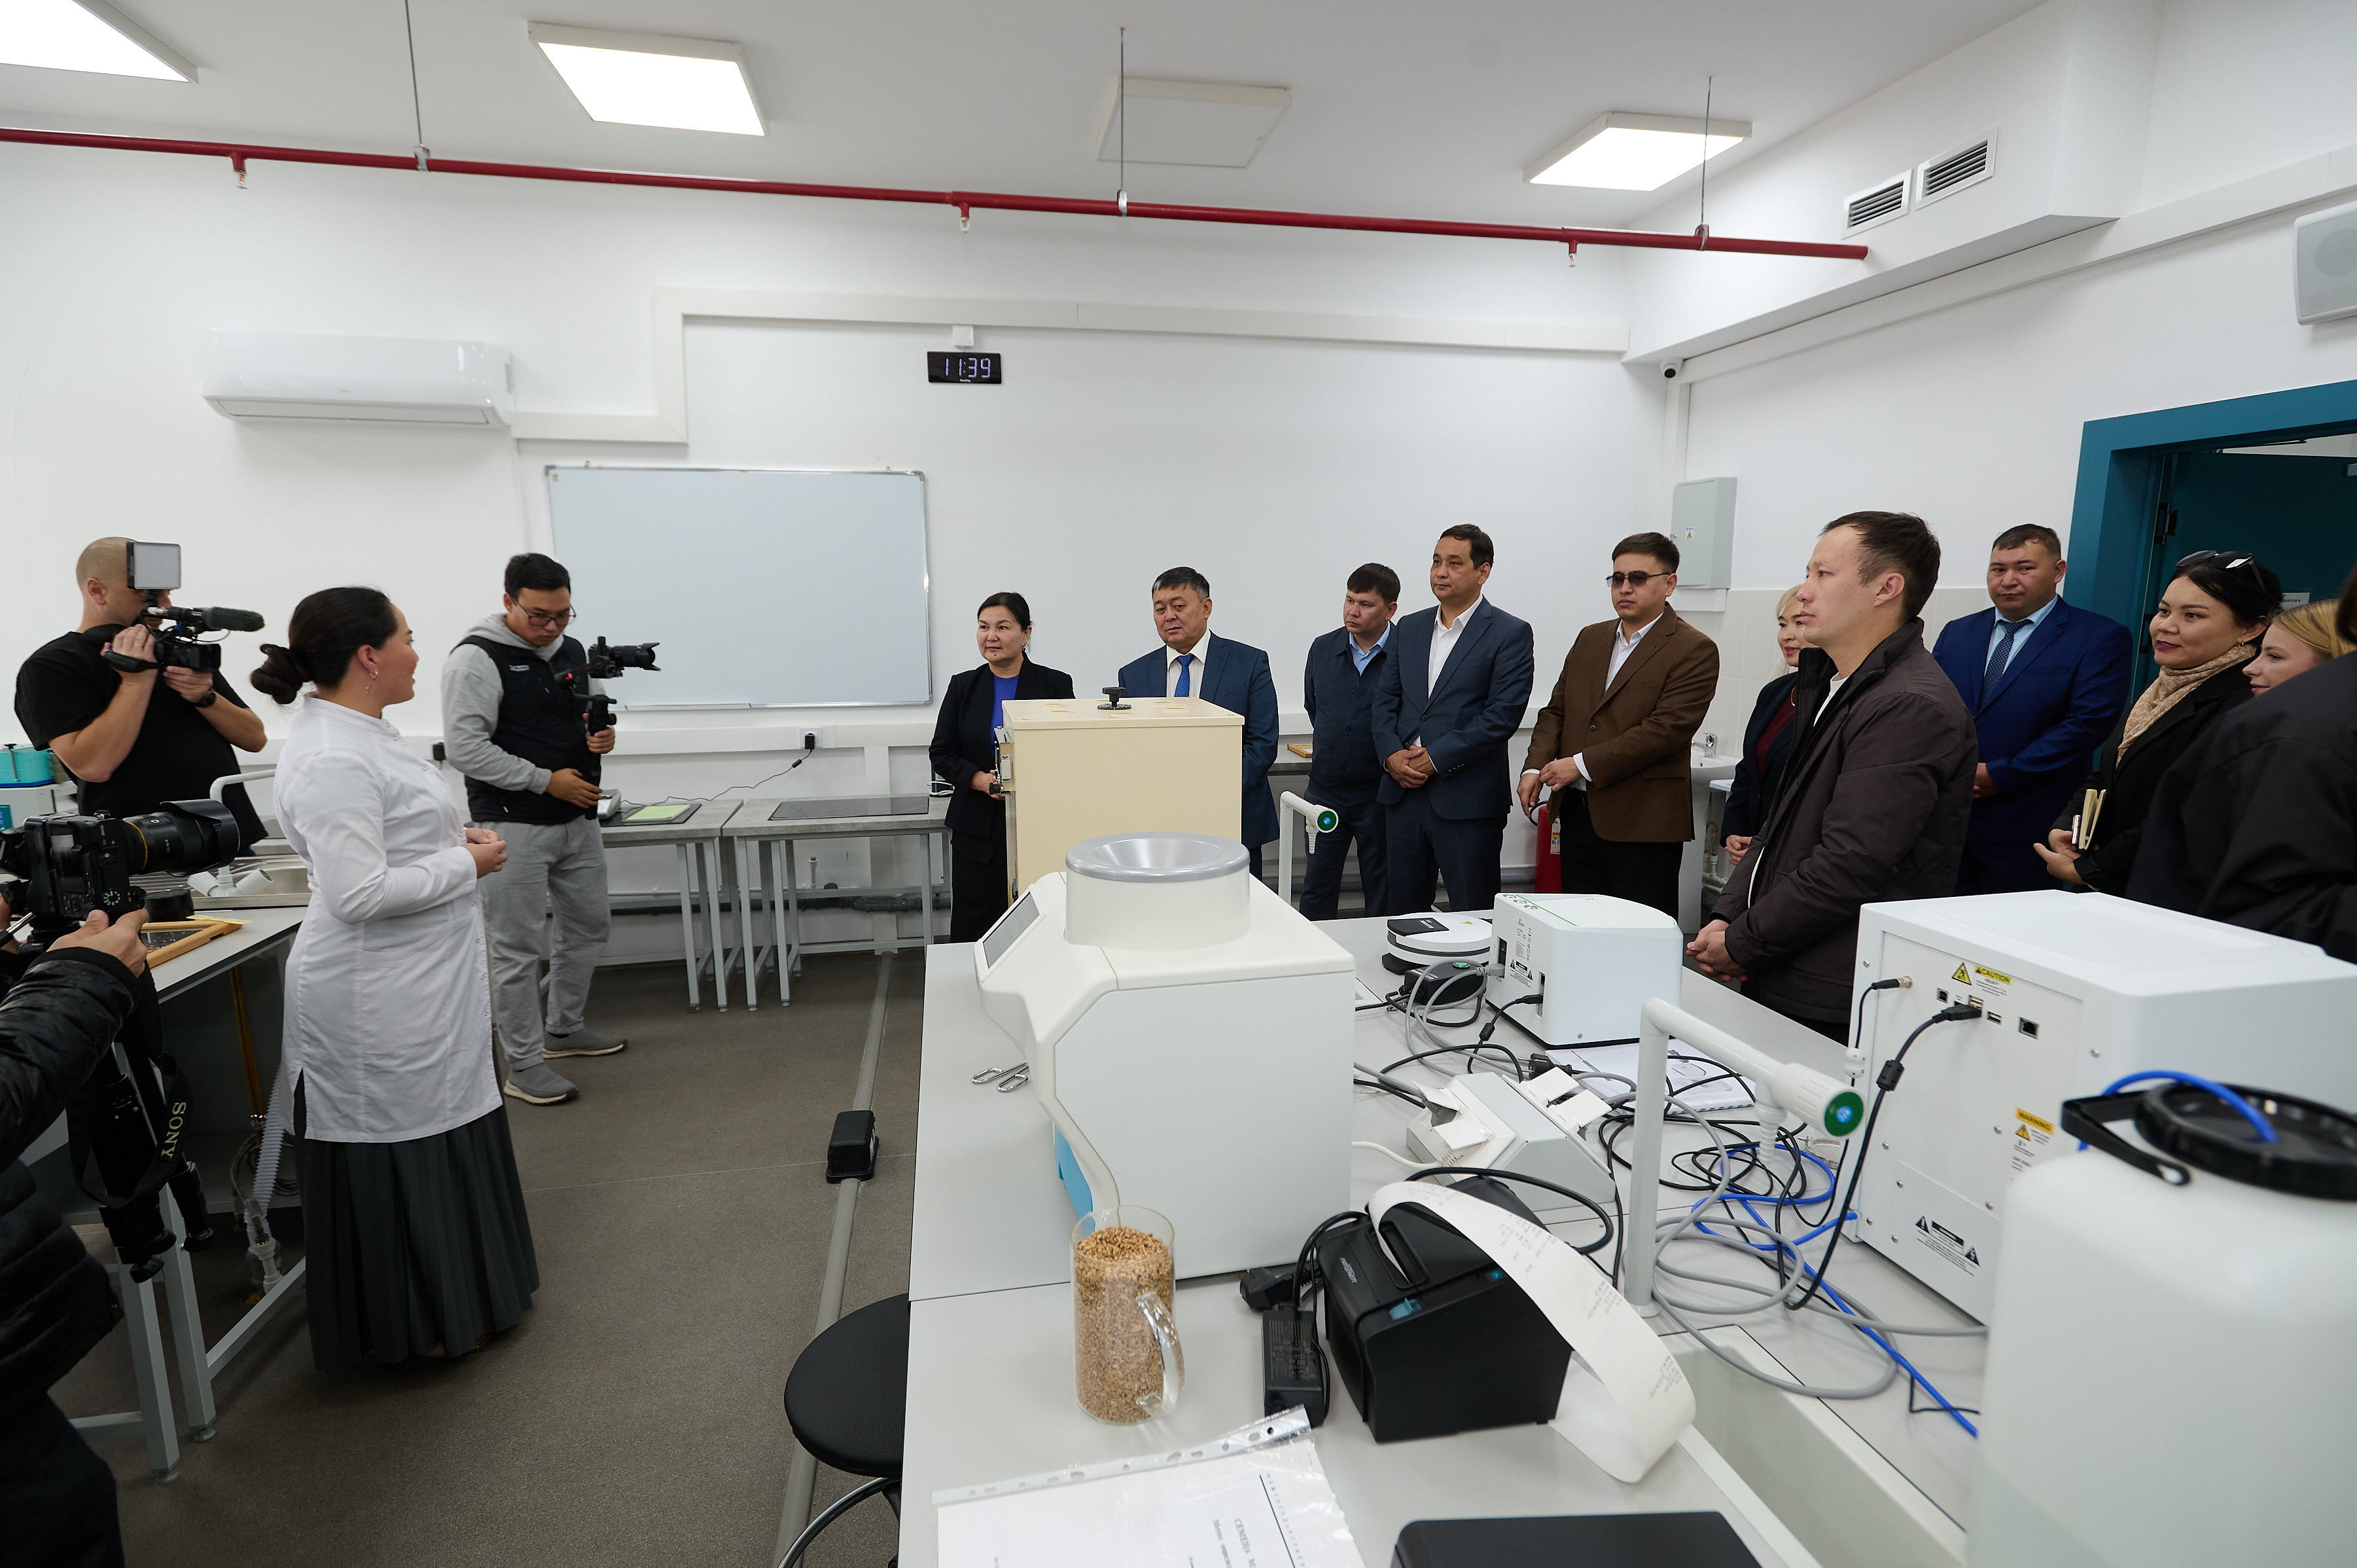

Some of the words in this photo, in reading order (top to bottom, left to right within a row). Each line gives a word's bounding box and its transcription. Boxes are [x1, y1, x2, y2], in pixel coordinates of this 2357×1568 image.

[945, 357, 991, 378] 11:39
[1981, 968, 2011, 984] CAUTION
[161, 1102, 187, 1159] SONY
[2019, 1111, 2052, 1131] WARNING
[1235, 1518, 1250, 1554] СЕМЕНА
